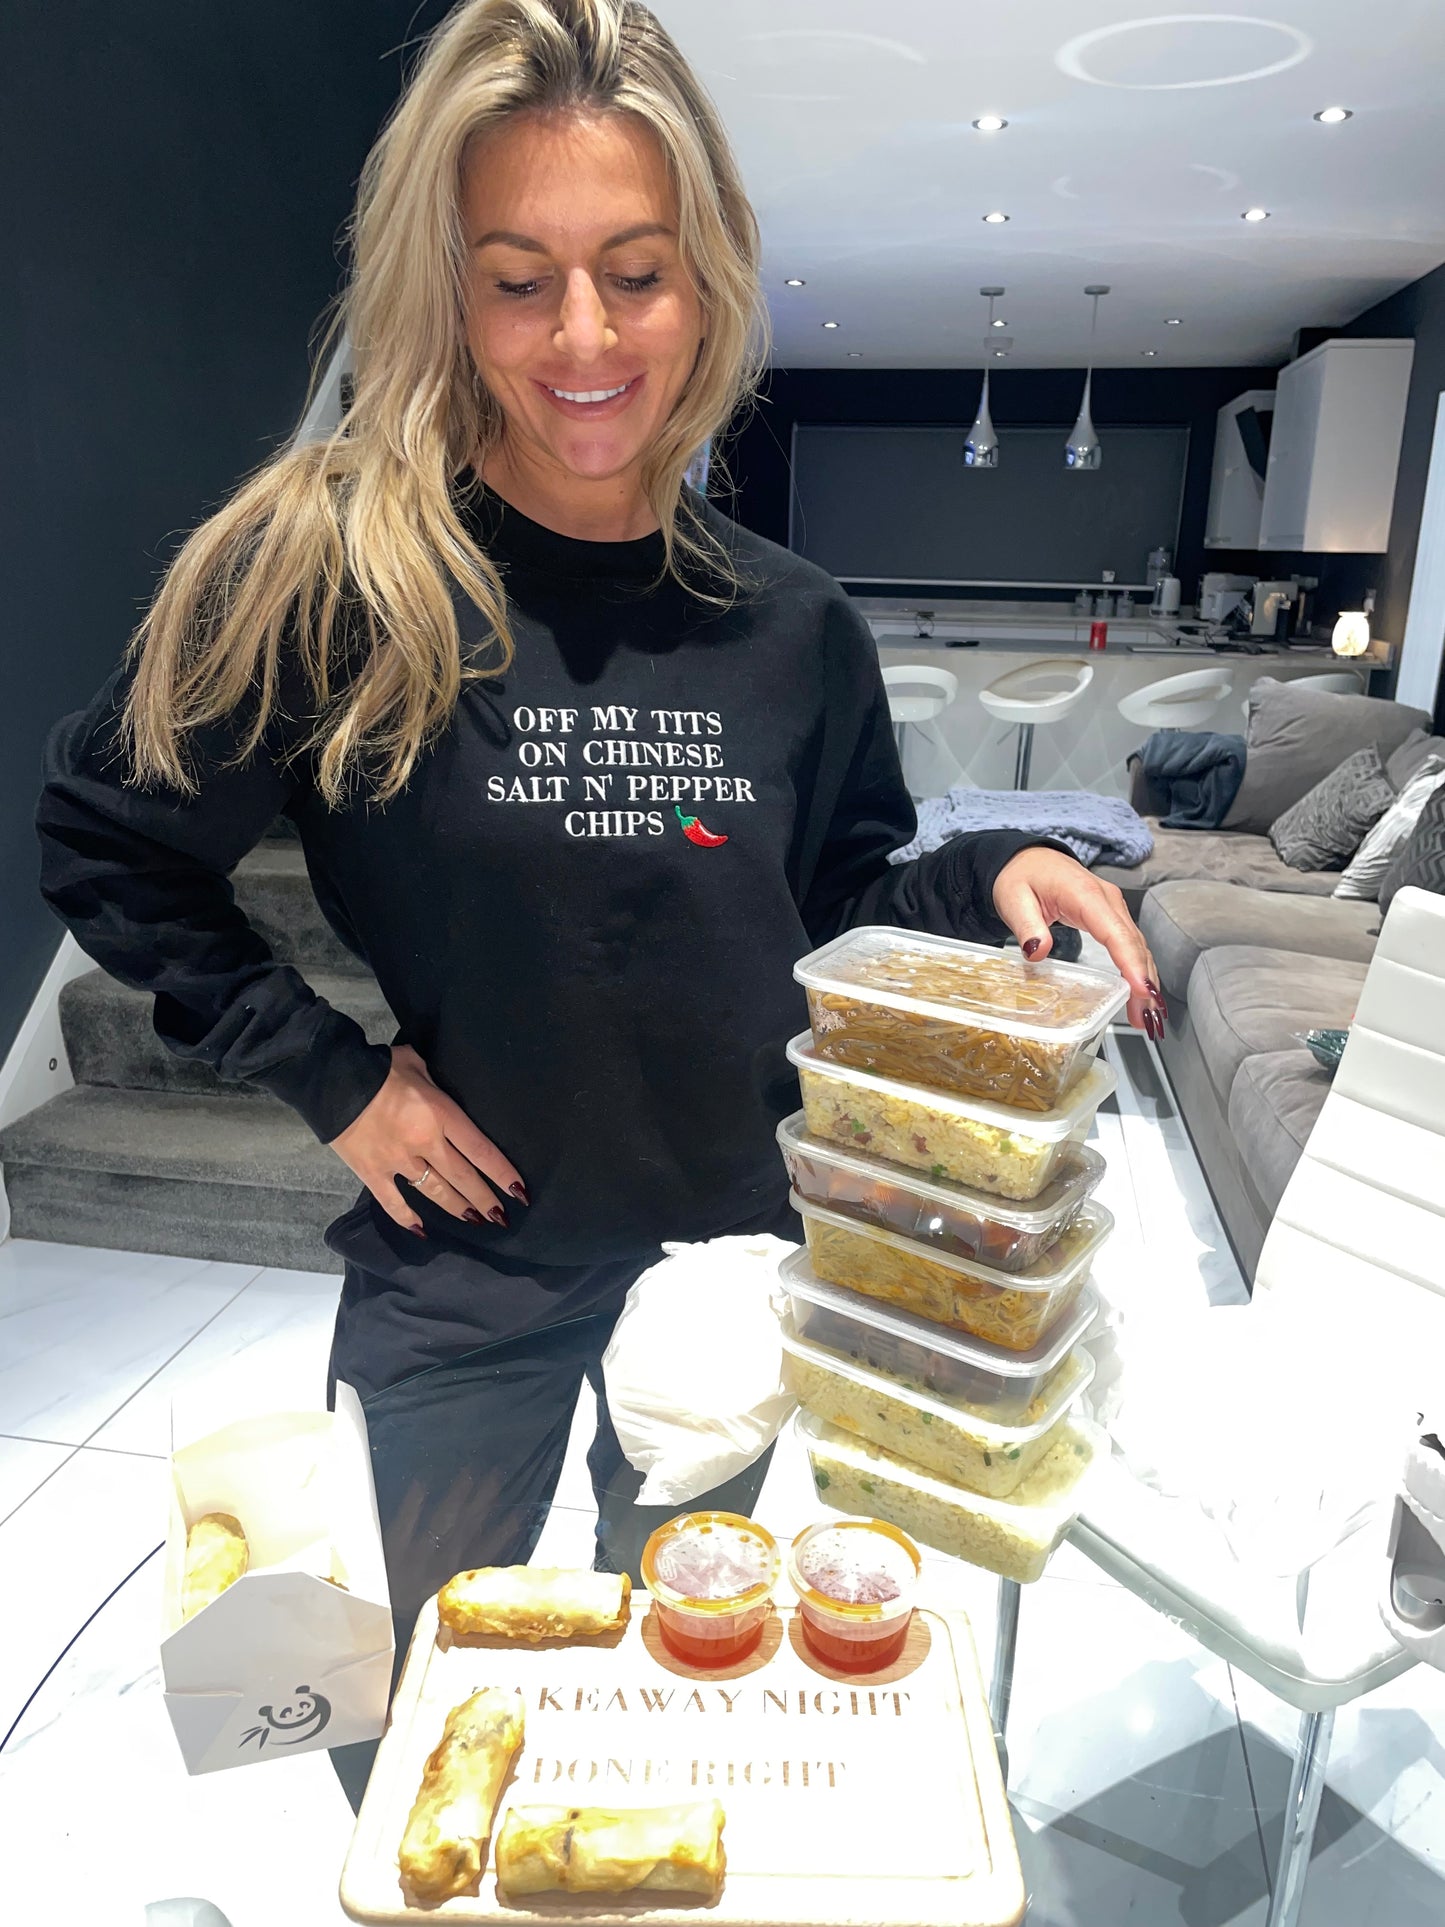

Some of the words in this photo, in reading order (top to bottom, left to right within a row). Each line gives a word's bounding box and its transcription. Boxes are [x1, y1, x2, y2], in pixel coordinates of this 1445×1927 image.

[513, 706, 579, 733] OFF
[590, 705, 639, 732] MY
[650, 709, 723, 736] TITS
[518, 741, 568, 769] ON
[582, 740, 725, 769] CHINESE
[486, 775, 570, 803] SALT
[582, 773, 613, 802] N'
[626, 774, 758, 803] PEPPER
[564, 810, 665, 838] CHIPS
[471, 1686, 743, 1713] KEAWAY
[762, 1688, 912, 1716] NIGHT
[531, 1757, 669, 1785] DONE
[690, 1759, 847, 1788] RIGHT
